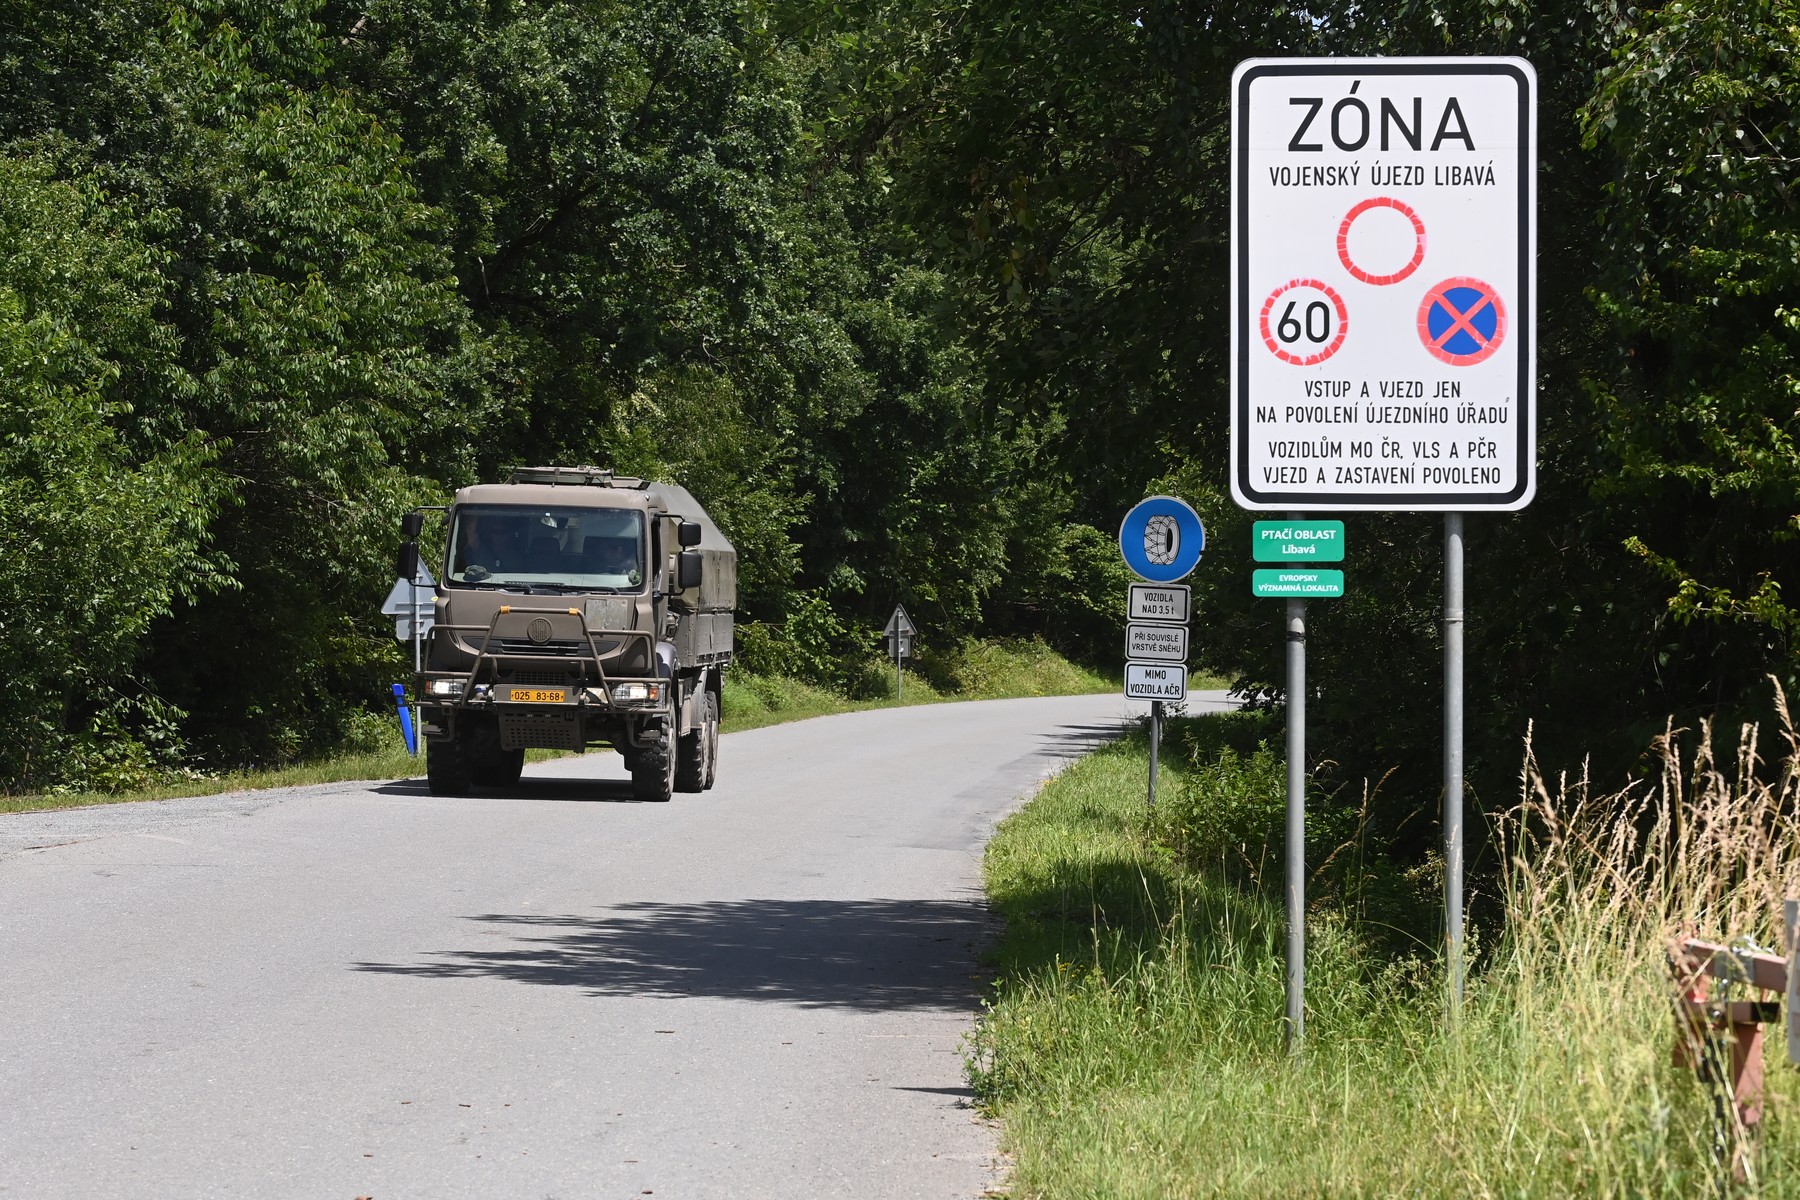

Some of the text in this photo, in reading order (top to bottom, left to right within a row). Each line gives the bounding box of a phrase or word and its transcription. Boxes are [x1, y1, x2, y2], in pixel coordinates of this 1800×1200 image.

[1287, 80, 1476, 152] ZÓNA
[1269, 160, 1496, 187] VOJENSKÝ ÚJEZD LIBAVÁ
[1277, 301, 1330, 343] 60
[1304, 381, 1461, 398] VSTUP A VJEZD JEN
[1256, 402, 1508, 424] NA POVOLENÍ ÚJEZDNÍHO ÚŘADU
[1268, 435, 1497, 460] VOZIDLŮM MO ČR, VLS A PČR
[1263, 462, 1501, 484] VJEZD A ZASTAVENÍ POVOLENO
[1261, 528, 1336, 540] PTAČÍ OBLAST
[1282, 544, 1316, 554] Libavá
[1279, 574, 1318, 582] EVROPSKY
[1258, 583, 1339, 592] VÝZNAMNÁ LOKALITA
[1144, 592, 1174, 603] VOZIDLA
[1142, 604, 1157, 614] NAD
[1171, 606, 1174, 615] t
[1134, 631, 1179, 643] PŘI SOUVISLÉ
[1131, 643, 1181, 653] VRSTVĚ SNĚHU
[1144, 669, 1167, 680] MIMO
[514, 691, 530, 700] 025
[1130, 683, 1180, 696] VOZIDLA AČR
